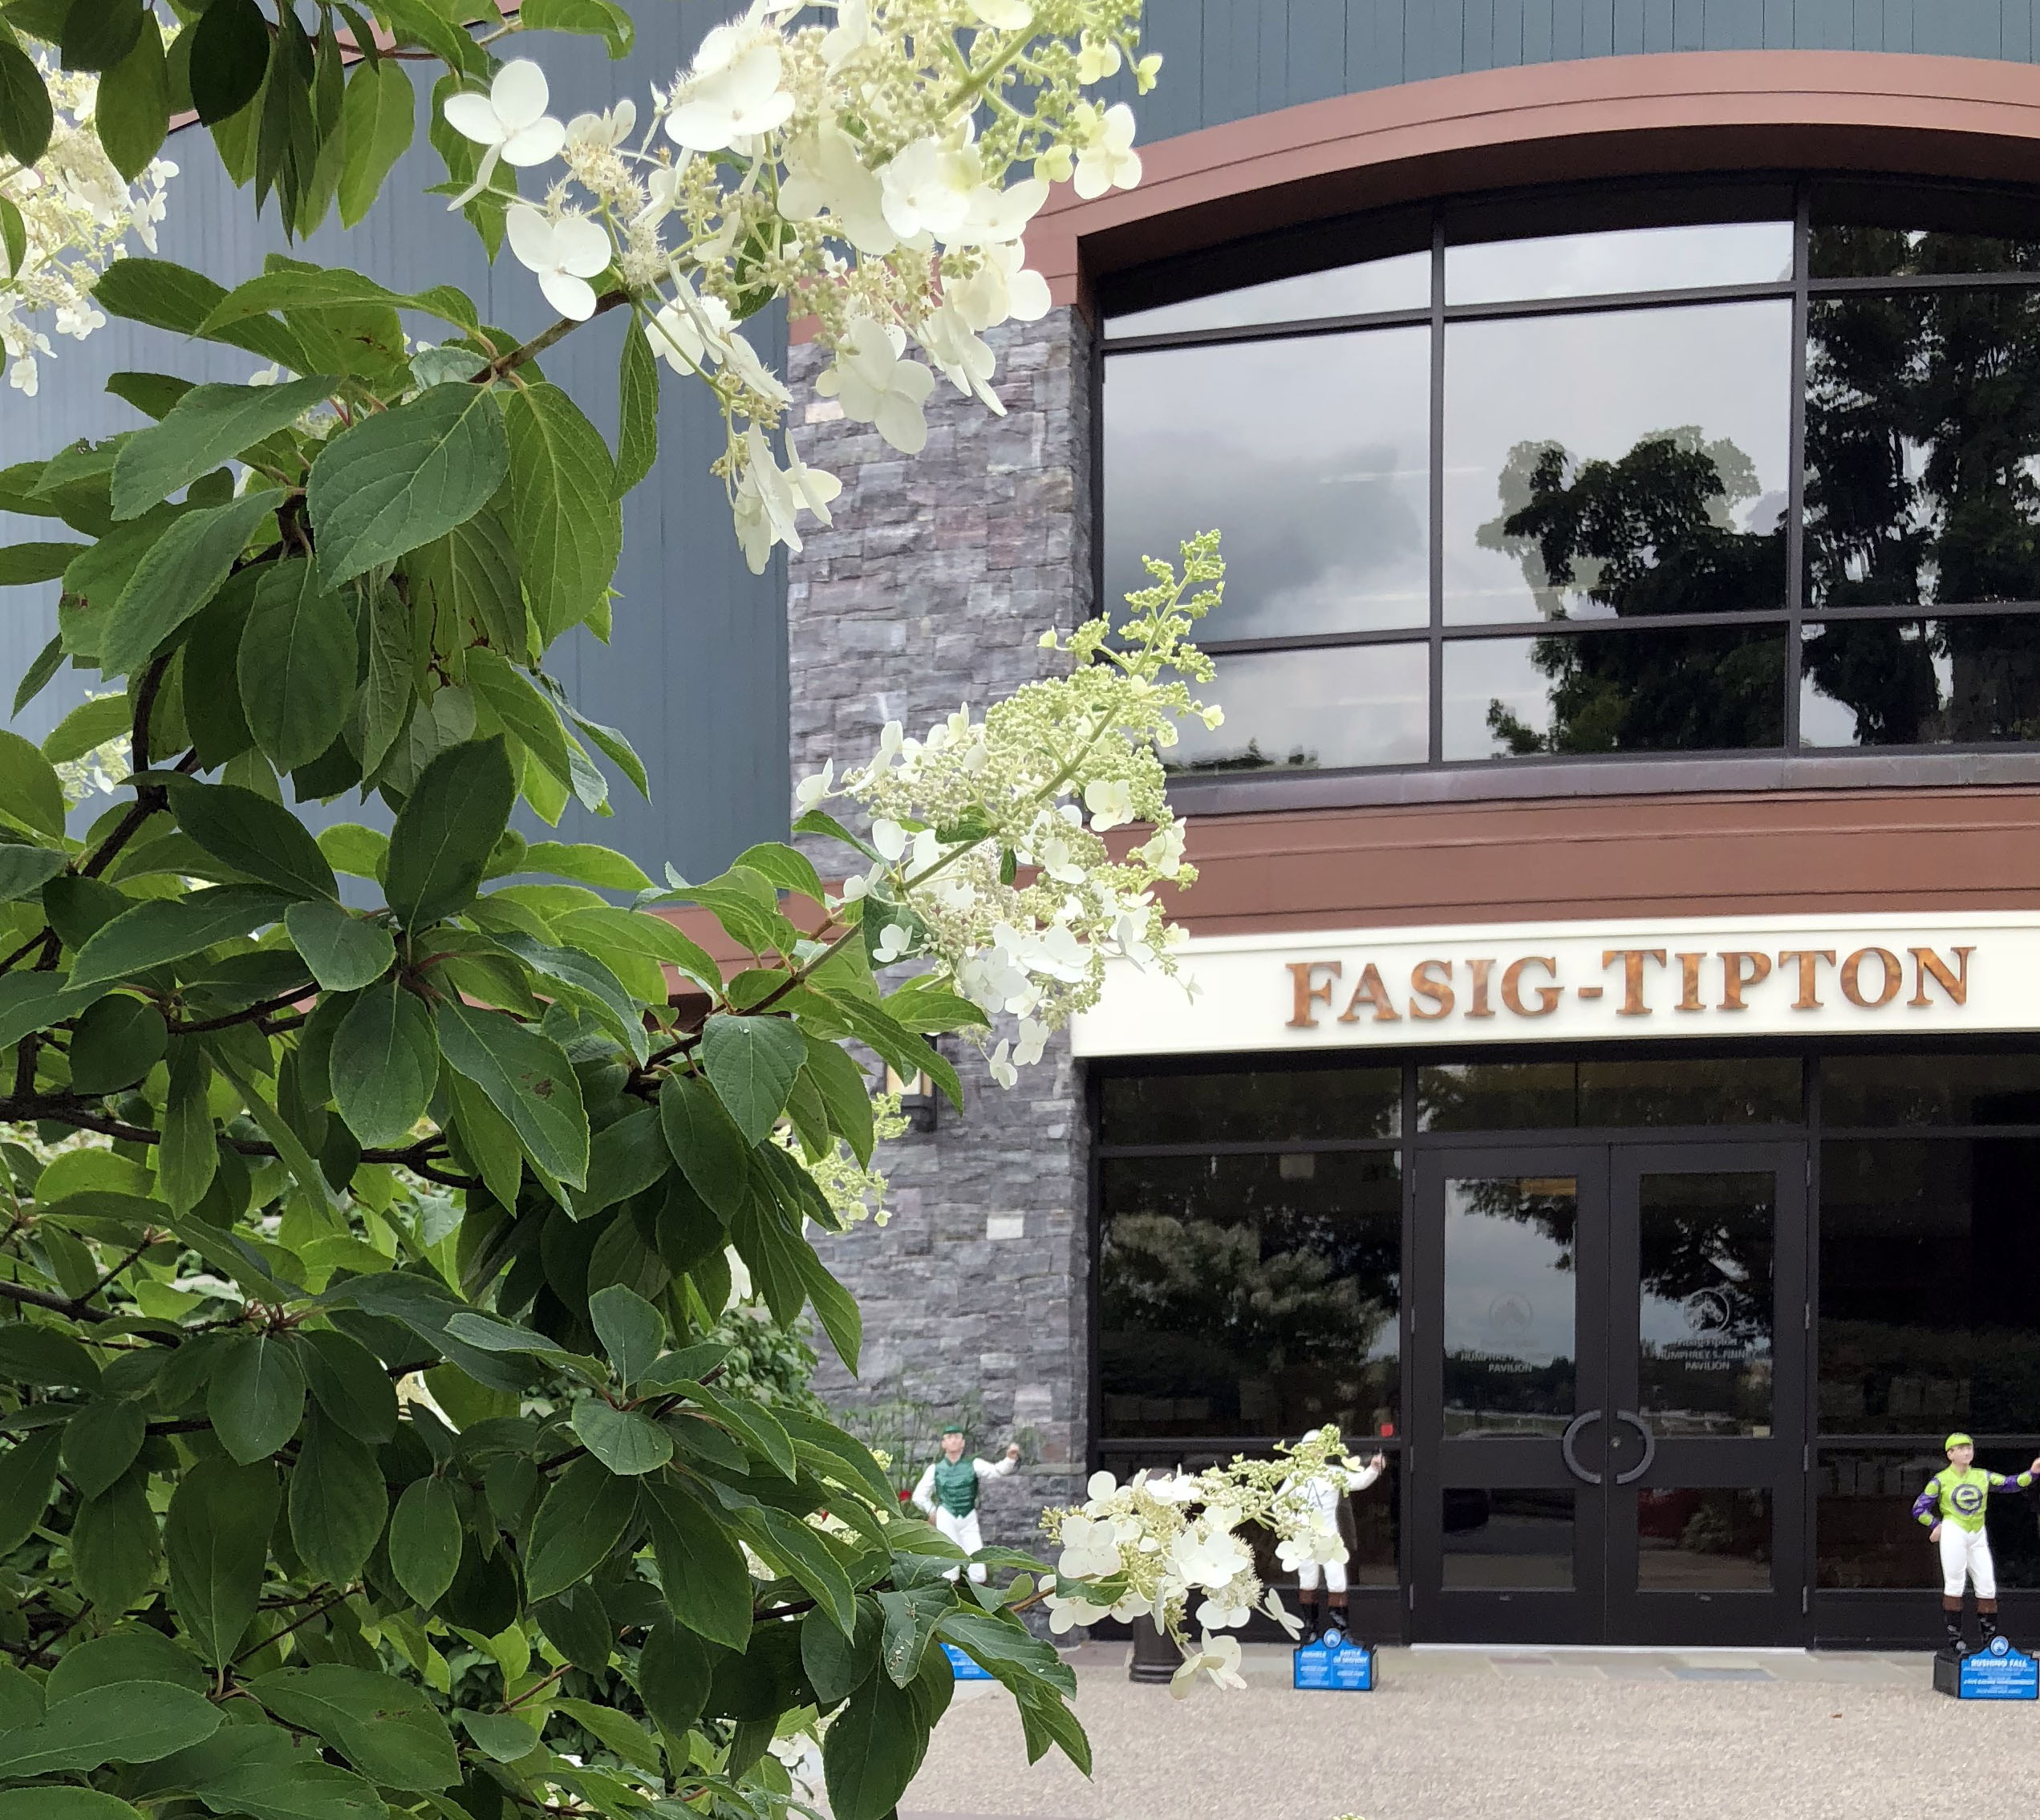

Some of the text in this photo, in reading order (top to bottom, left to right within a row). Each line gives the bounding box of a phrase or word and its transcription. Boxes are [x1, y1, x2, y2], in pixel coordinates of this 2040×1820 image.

[1284, 946, 1977, 1028] FASIG-TIPTON
[1488, 1363, 1533, 1373] PAVILION
[1685, 1360, 1730, 1371] PAVILION
[2009, 1658, 2028, 1668] FALL
